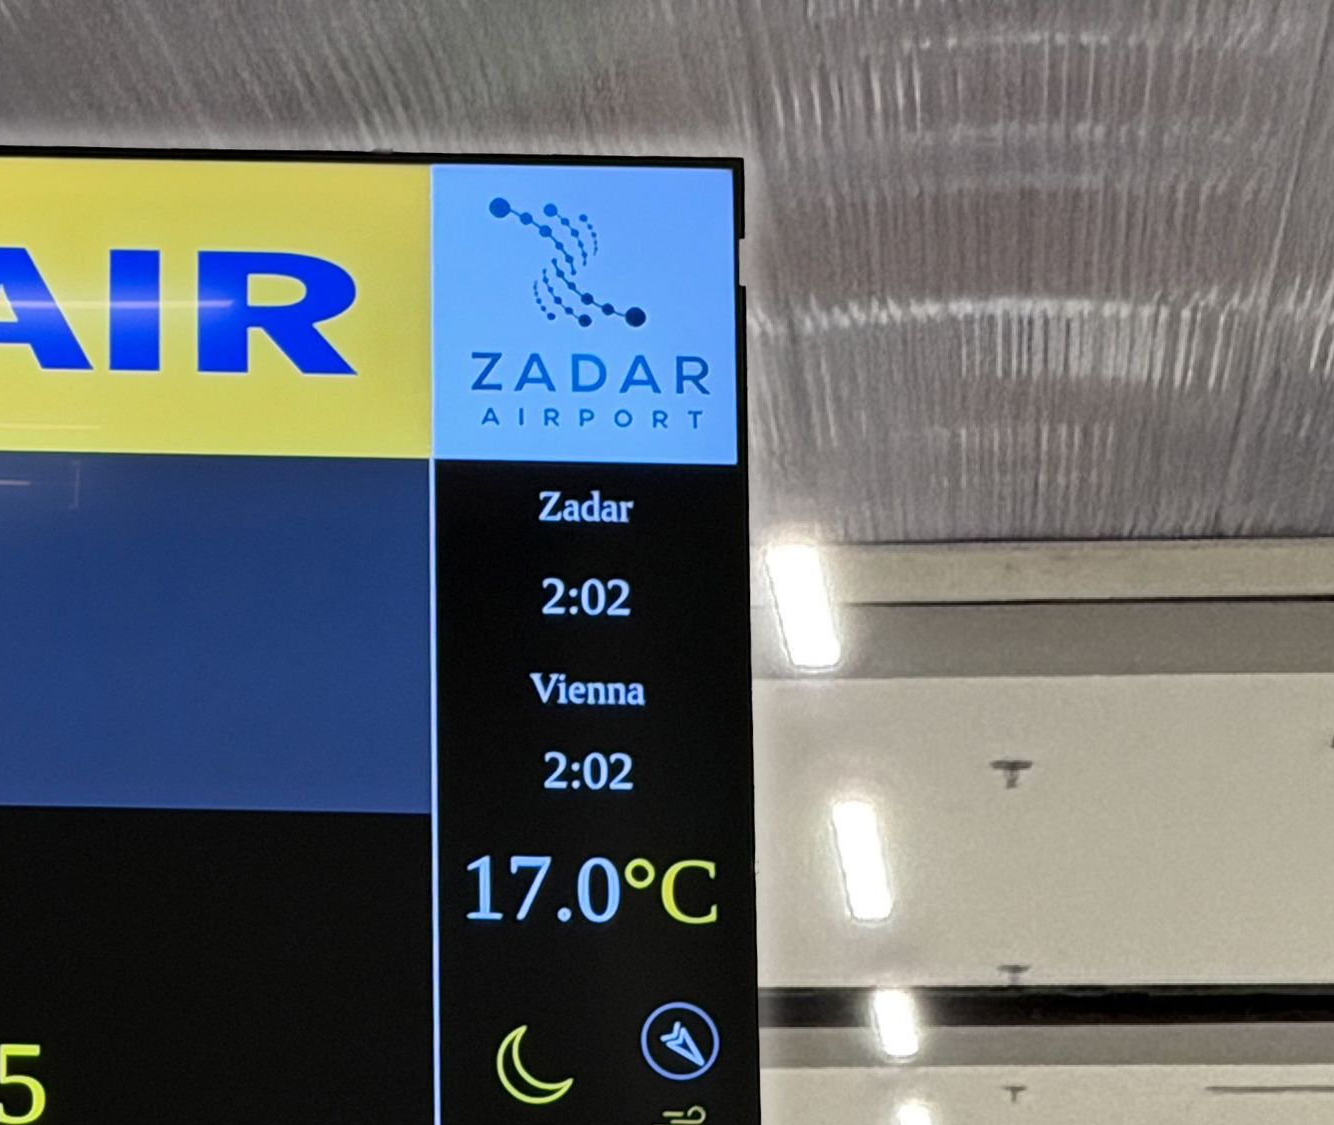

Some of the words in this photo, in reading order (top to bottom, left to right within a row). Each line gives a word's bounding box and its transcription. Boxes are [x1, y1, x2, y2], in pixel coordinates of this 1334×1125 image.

[471, 351, 711, 396] ZADAR
[480, 406, 704, 430] AIRPORT
[538, 490, 634, 523] Zadar
[541, 577, 631, 617] 2:02
[529, 672, 646, 706] Vienna
[543, 751, 634, 791] 2:02
